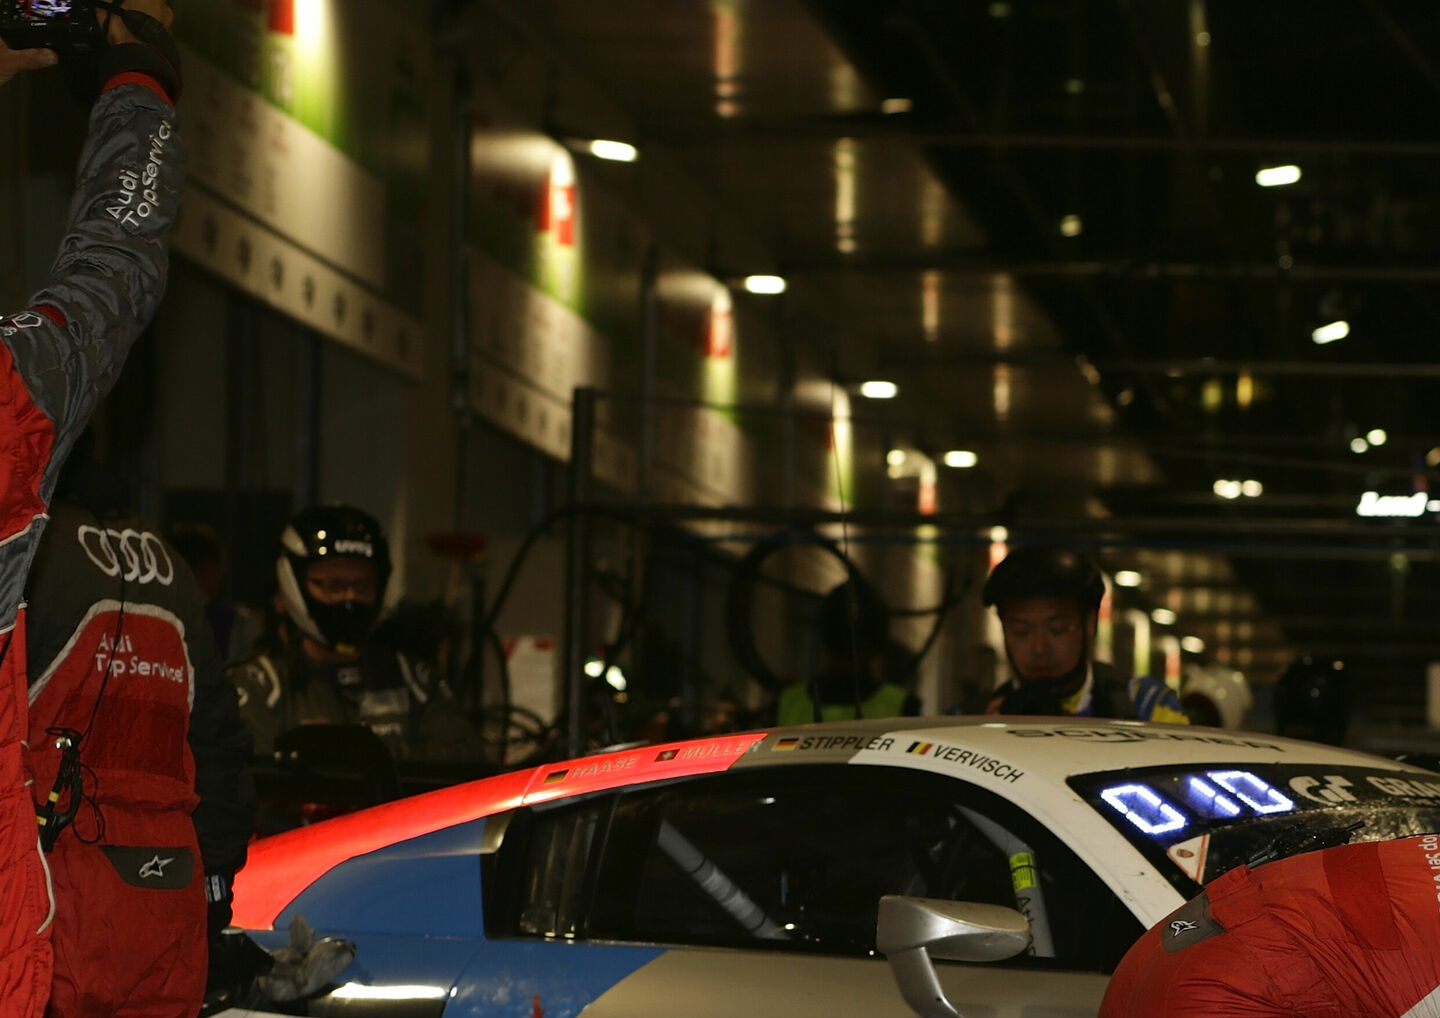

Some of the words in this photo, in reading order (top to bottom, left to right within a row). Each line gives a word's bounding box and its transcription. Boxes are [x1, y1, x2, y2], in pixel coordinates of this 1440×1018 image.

[106, 168, 139, 220] Audi
[129, 656, 185, 684] Service
[800, 734, 896, 753] STIPPLER
[1006, 727, 1287, 753] SCHERER
[570, 755, 636, 780] HAASE
[930, 744, 1025, 785] VERVISCH
